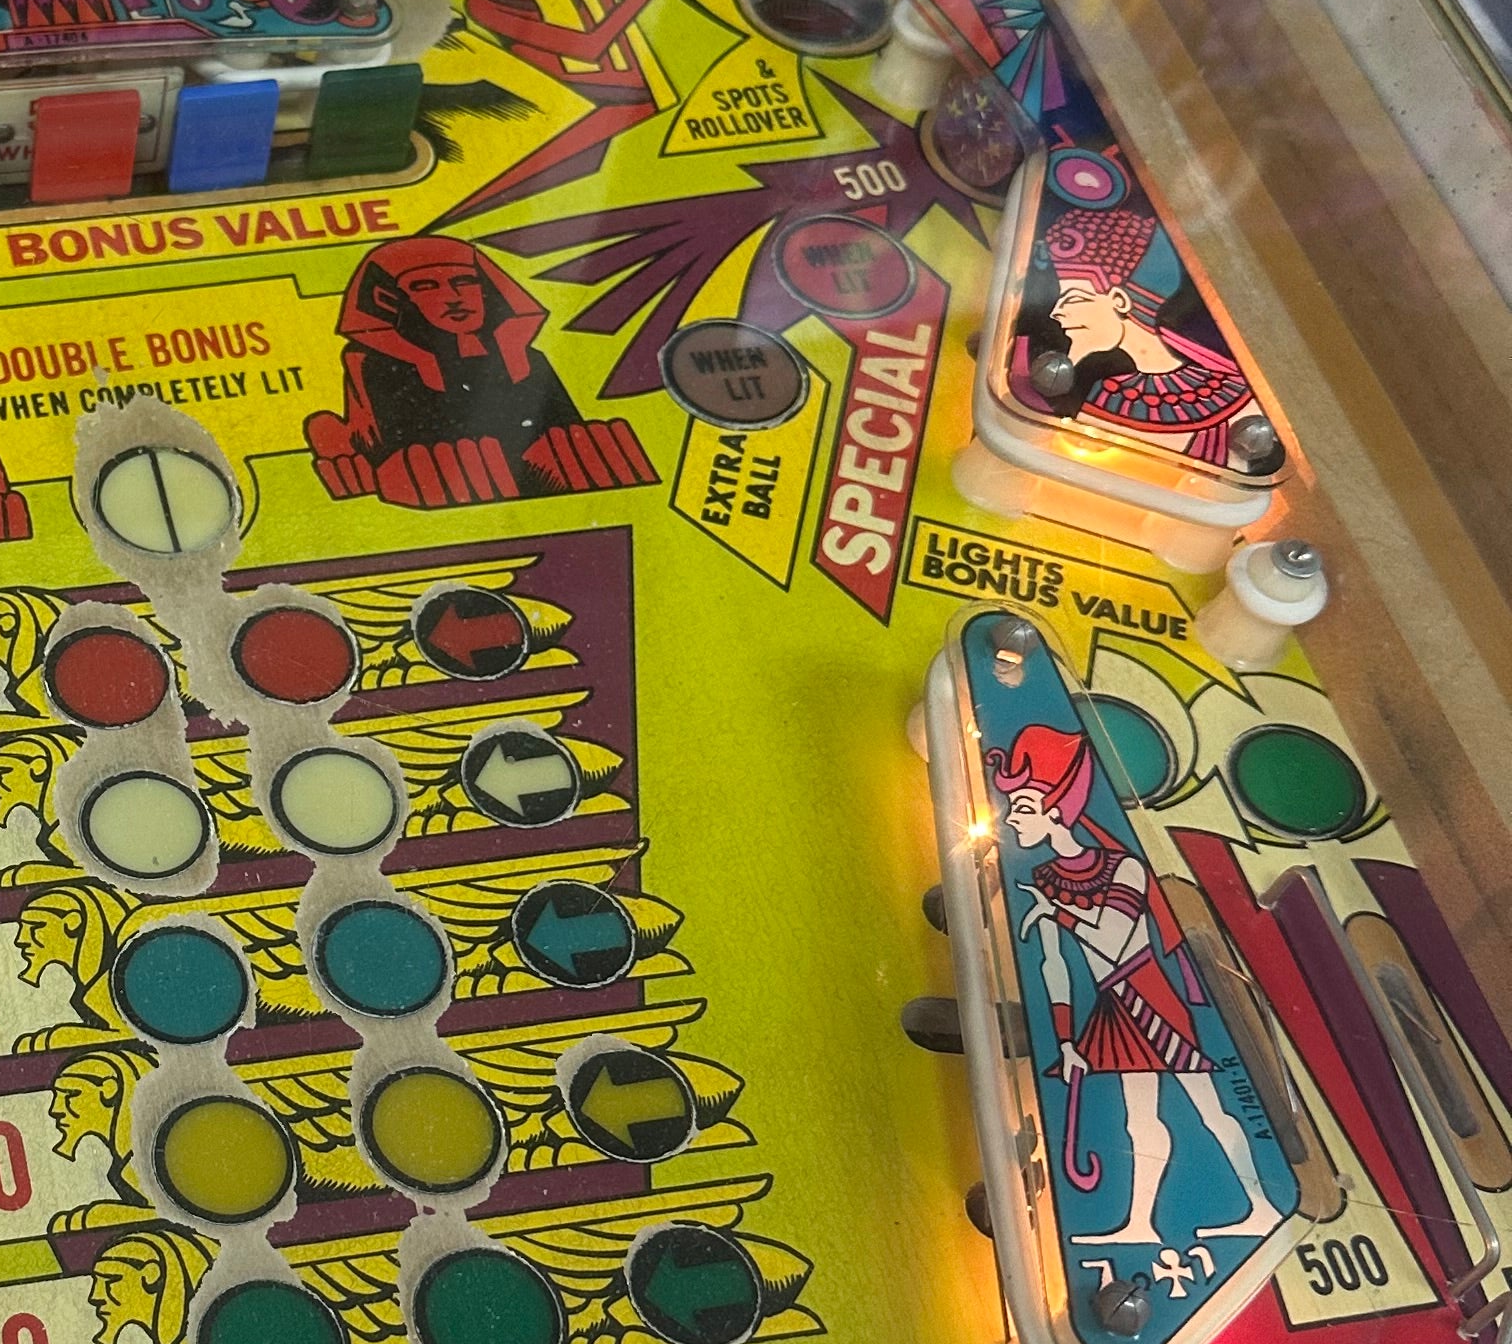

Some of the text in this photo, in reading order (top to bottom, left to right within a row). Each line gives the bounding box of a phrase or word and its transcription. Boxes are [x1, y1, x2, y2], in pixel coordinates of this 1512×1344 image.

[758, 59, 776, 79] &
[711, 83, 789, 110] SPOTS
[684, 106, 808, 141] ROLLOVER
[833, 161, 907, 201] 500
[6, 214, 204, 269] BONUS
[215, 198, 400, 249] VALUE
[830, 269, 871, 295] LIT
[145, 322, 271, 368] BONUS
[689, 346, 769, 376] WHEN
[260, 366, 304, 395] LIT
[723, 375, 767, 402] LIT
[821, 323, 933, 575] SPECIAL
[701, 433, 748, 527] EXTRA
[742, 455, 781, 520] BALL
[926, 533, 1064, 585] LIGHTS
[922, 555, 1188, 641] BONUS VALUE
[1297, 1234, 1389, 1296] 500
